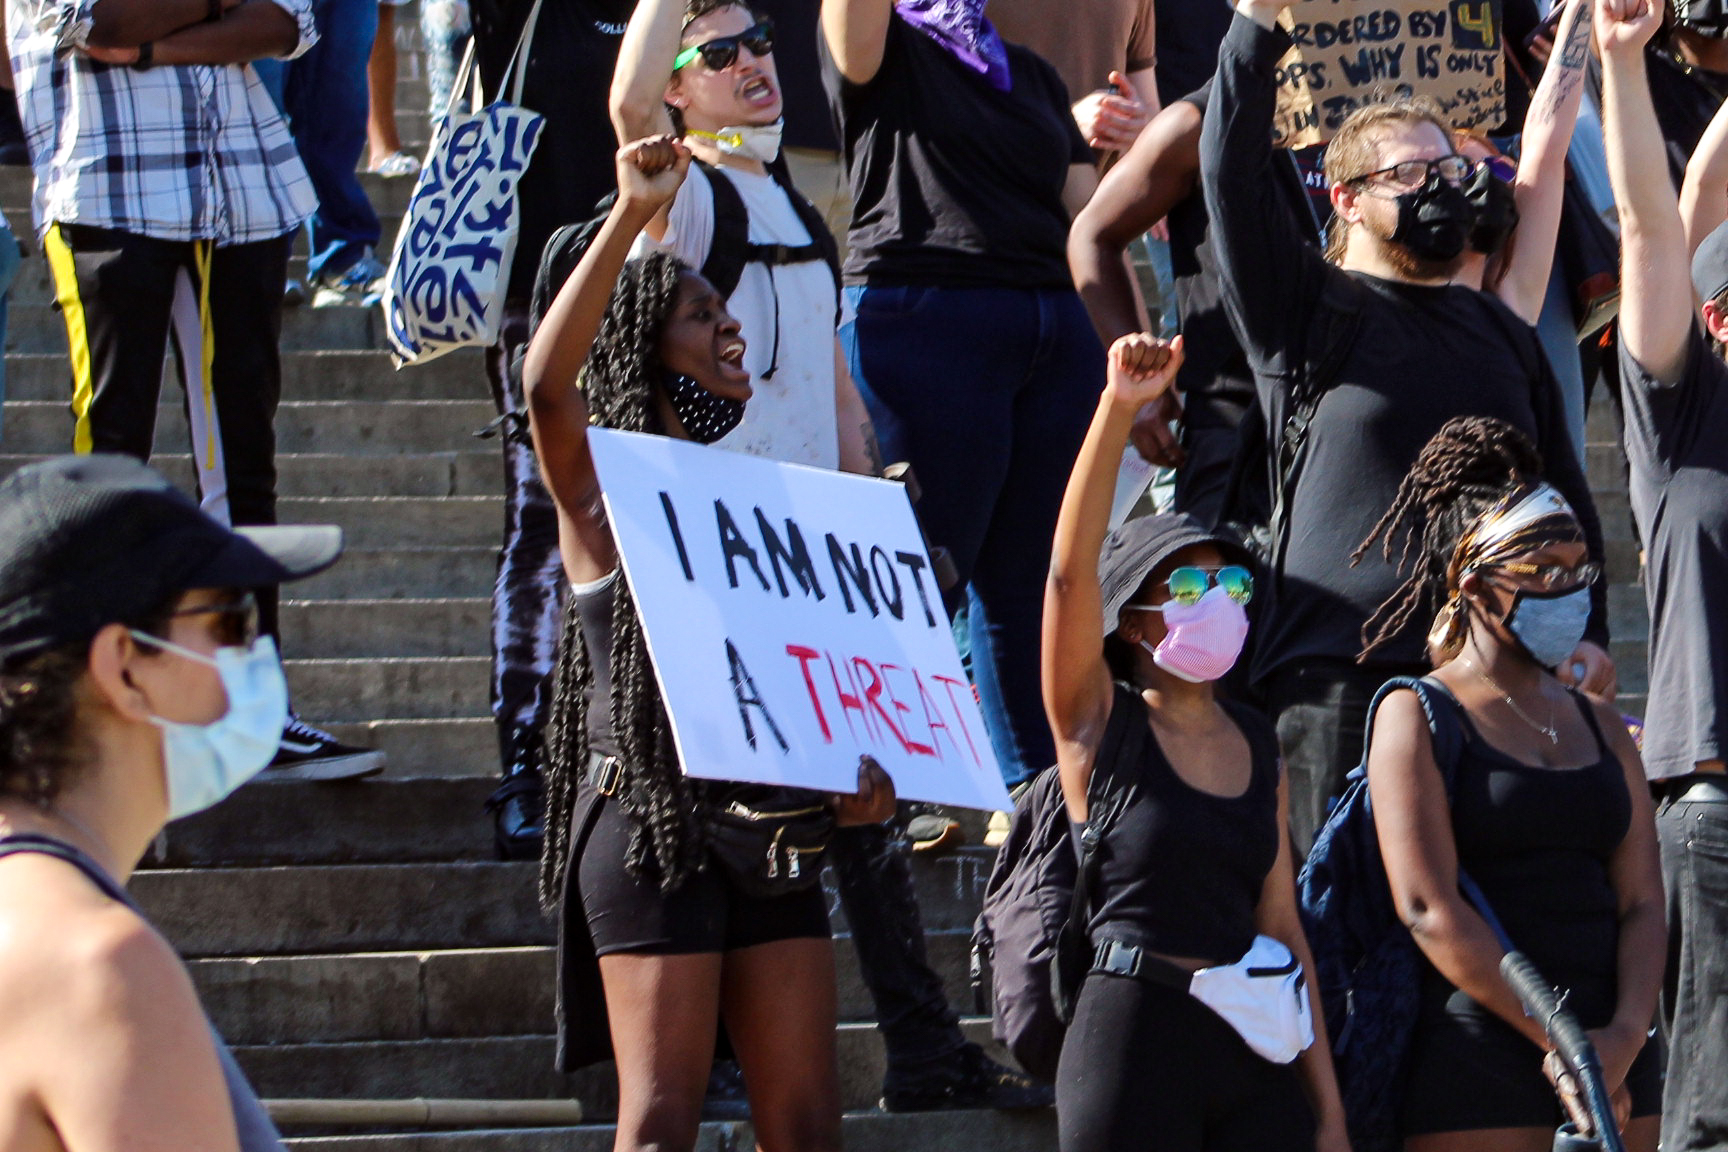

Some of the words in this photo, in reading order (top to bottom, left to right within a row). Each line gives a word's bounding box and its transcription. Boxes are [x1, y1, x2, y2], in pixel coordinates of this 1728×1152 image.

[1291, 8, 1401, 49] RDERED
[1408, 8, 1446, 38] BY
[1456, 0, 1495, 50] 4
[1339, 42, 1406, 89] WHY
[1416, 45, 1442, 79] IS
[1446, 52, 1498, 77] ONLY
[658, 491, 695, 582] I
[713, 497, 827, 603] AM
[825, 531, 938, 629] NOT
[724, 637, 790, 756] A
[785, 643, 983, 770] THREAT
